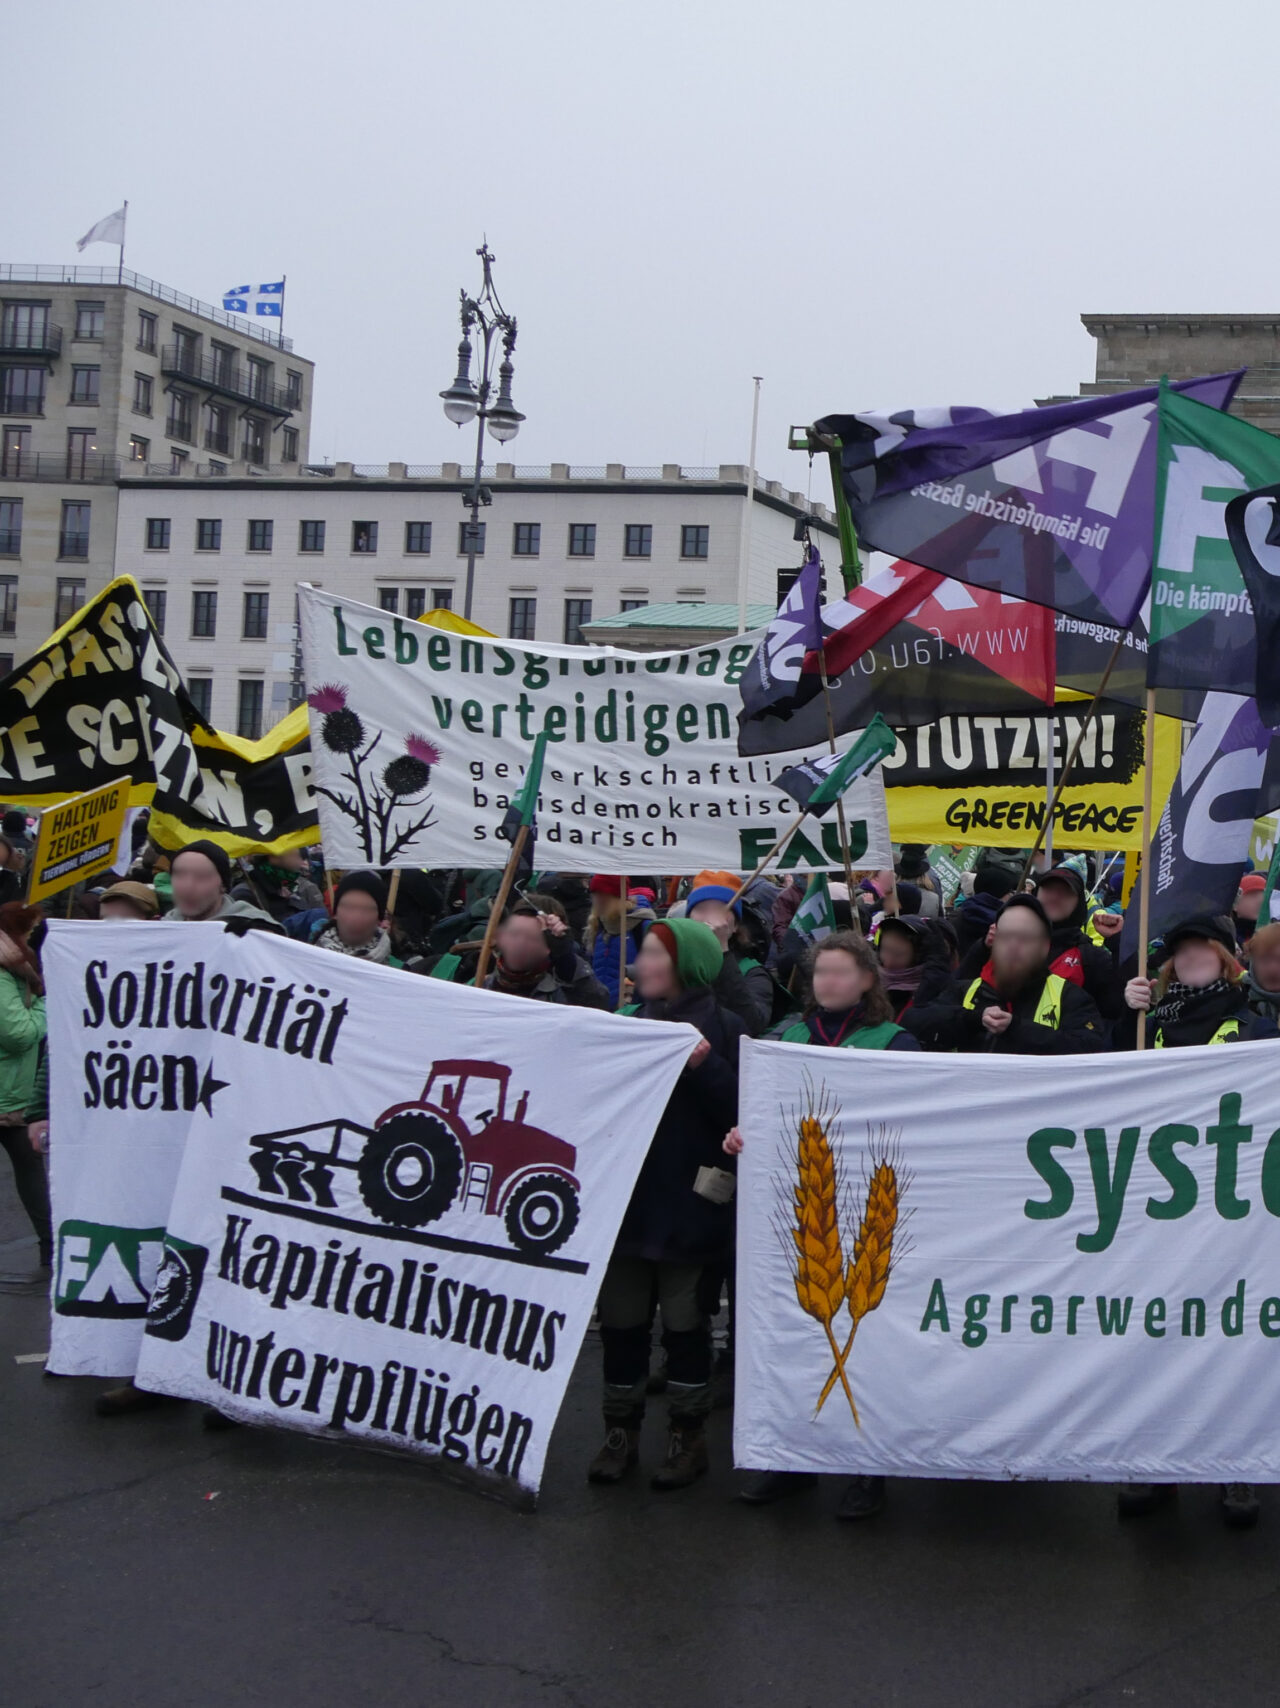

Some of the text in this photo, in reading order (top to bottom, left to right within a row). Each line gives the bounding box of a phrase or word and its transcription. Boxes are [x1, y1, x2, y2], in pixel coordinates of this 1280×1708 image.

[1155, 580, 1254, 617] Die kämpfe
[431, 688, 730, 757] verteidigen
[469, 757, 808, 786] geerkschaftli
[52, 790, 119, 835] HALTUNG
[473, 787, 806, 819] baisdemokratisc
[945, 797, 1144, 834] GREENPEACE
[47, 822, 100, 862] ZEIGEN
[473, 821, 678, 847] soidarisch
[739, 820, 869, 872] FAU
[83, 960, 348, 1064] Solidarität
[83, 1040, 201, 1113] säen
[218, 1214, 566, 1371] Kapitalismus
[206, 1320, 534, 1478] unterpflügen
